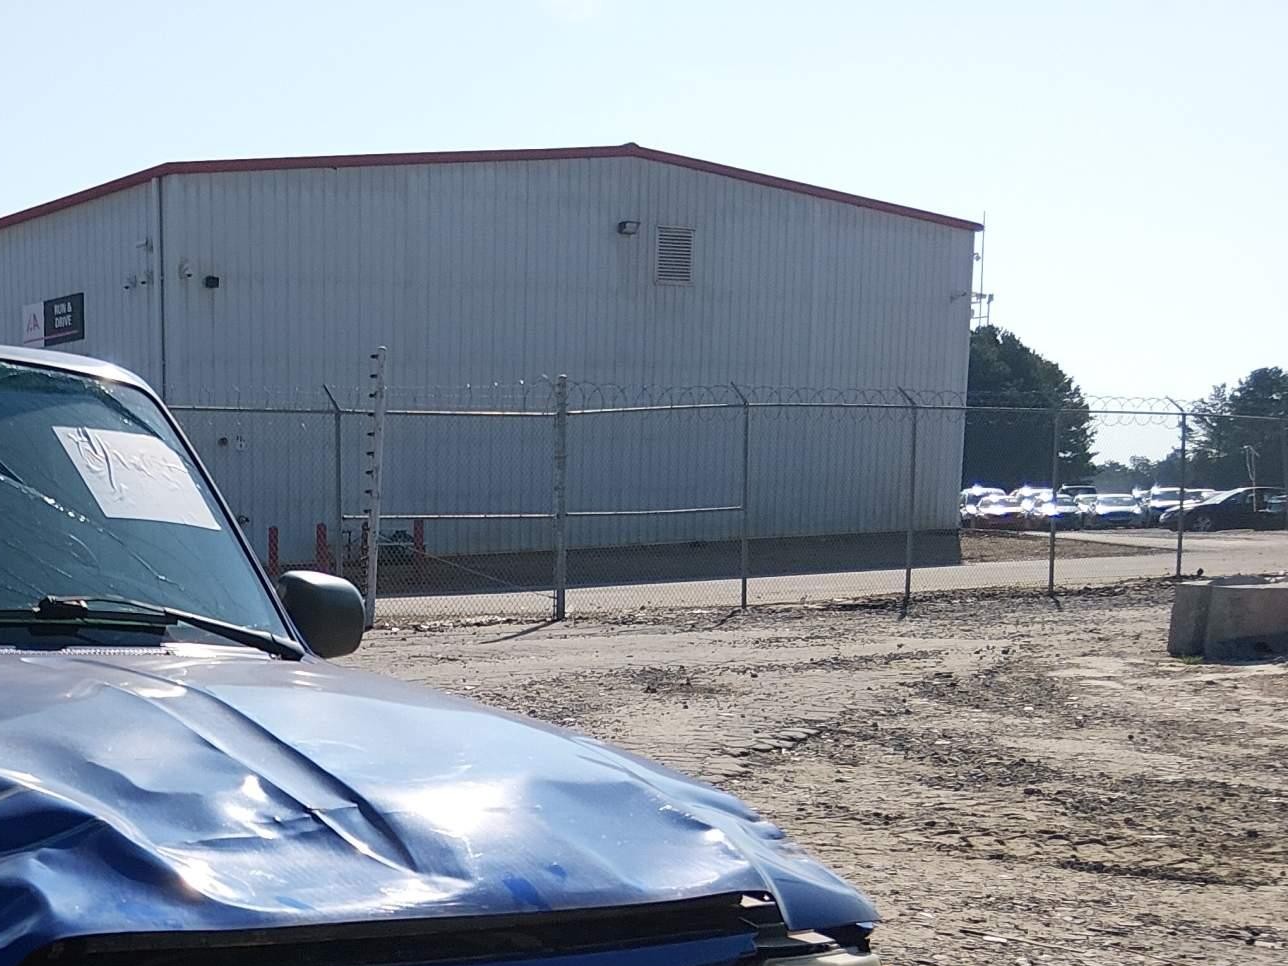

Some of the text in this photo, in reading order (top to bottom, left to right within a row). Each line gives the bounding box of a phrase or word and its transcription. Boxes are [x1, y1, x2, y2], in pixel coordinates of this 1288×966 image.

[54, 301, 72, 316] RUN &
[54, 314, 72, 329] DRIVE
